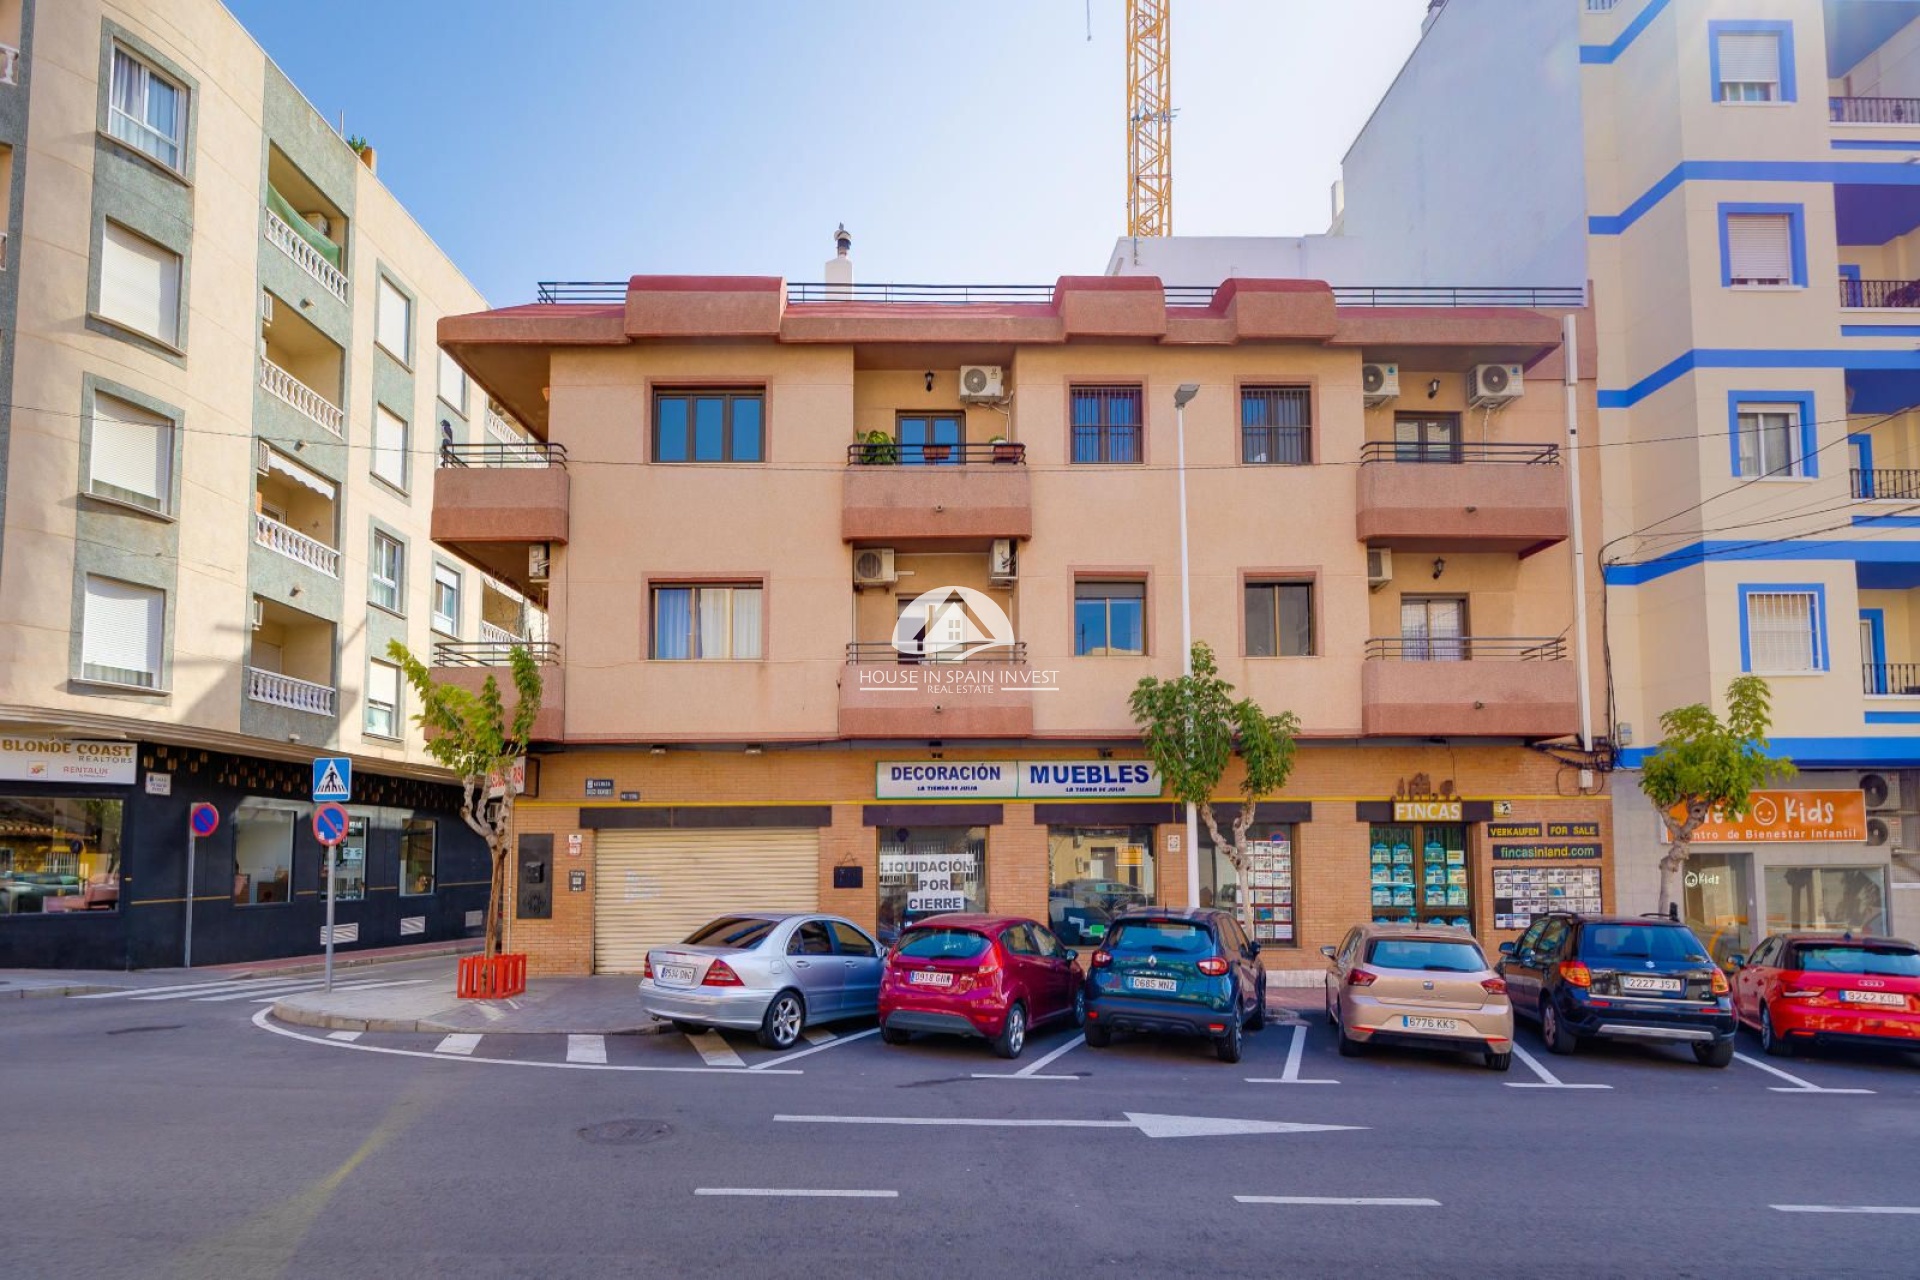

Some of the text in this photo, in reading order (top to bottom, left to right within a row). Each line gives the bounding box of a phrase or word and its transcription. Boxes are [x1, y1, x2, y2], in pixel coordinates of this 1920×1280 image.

[2, 739, 134, 757] BLONDE COAST
[78, 755, 133, 764] REALTORS
[891, 763, 1000, 781] DECORACIÓN
[1030, 765, 1150, 784] MUEBLES
[1394, 803, 1461, 820] FINCAS
[1783, 797, 1835, 823] Kids
[1490, 827, 1540, 837] VERKAUFEN
[1550, 826, 1596, 835] FOR SALE
[1727, 829, 1739, 839] de
[1746, 829, 1805, 839] Bienestar
[1811, 828, 1857, 838] Infantil
[1501, 846, 1595, 858] fincasinland.com
[880, 858, 974, 872] LIQUIDACIÓN
[919, 879, 949, 891] POR
[909, 898, 962, 909] CIERRE
[1436, 1019, 1456, 1029] KKS
